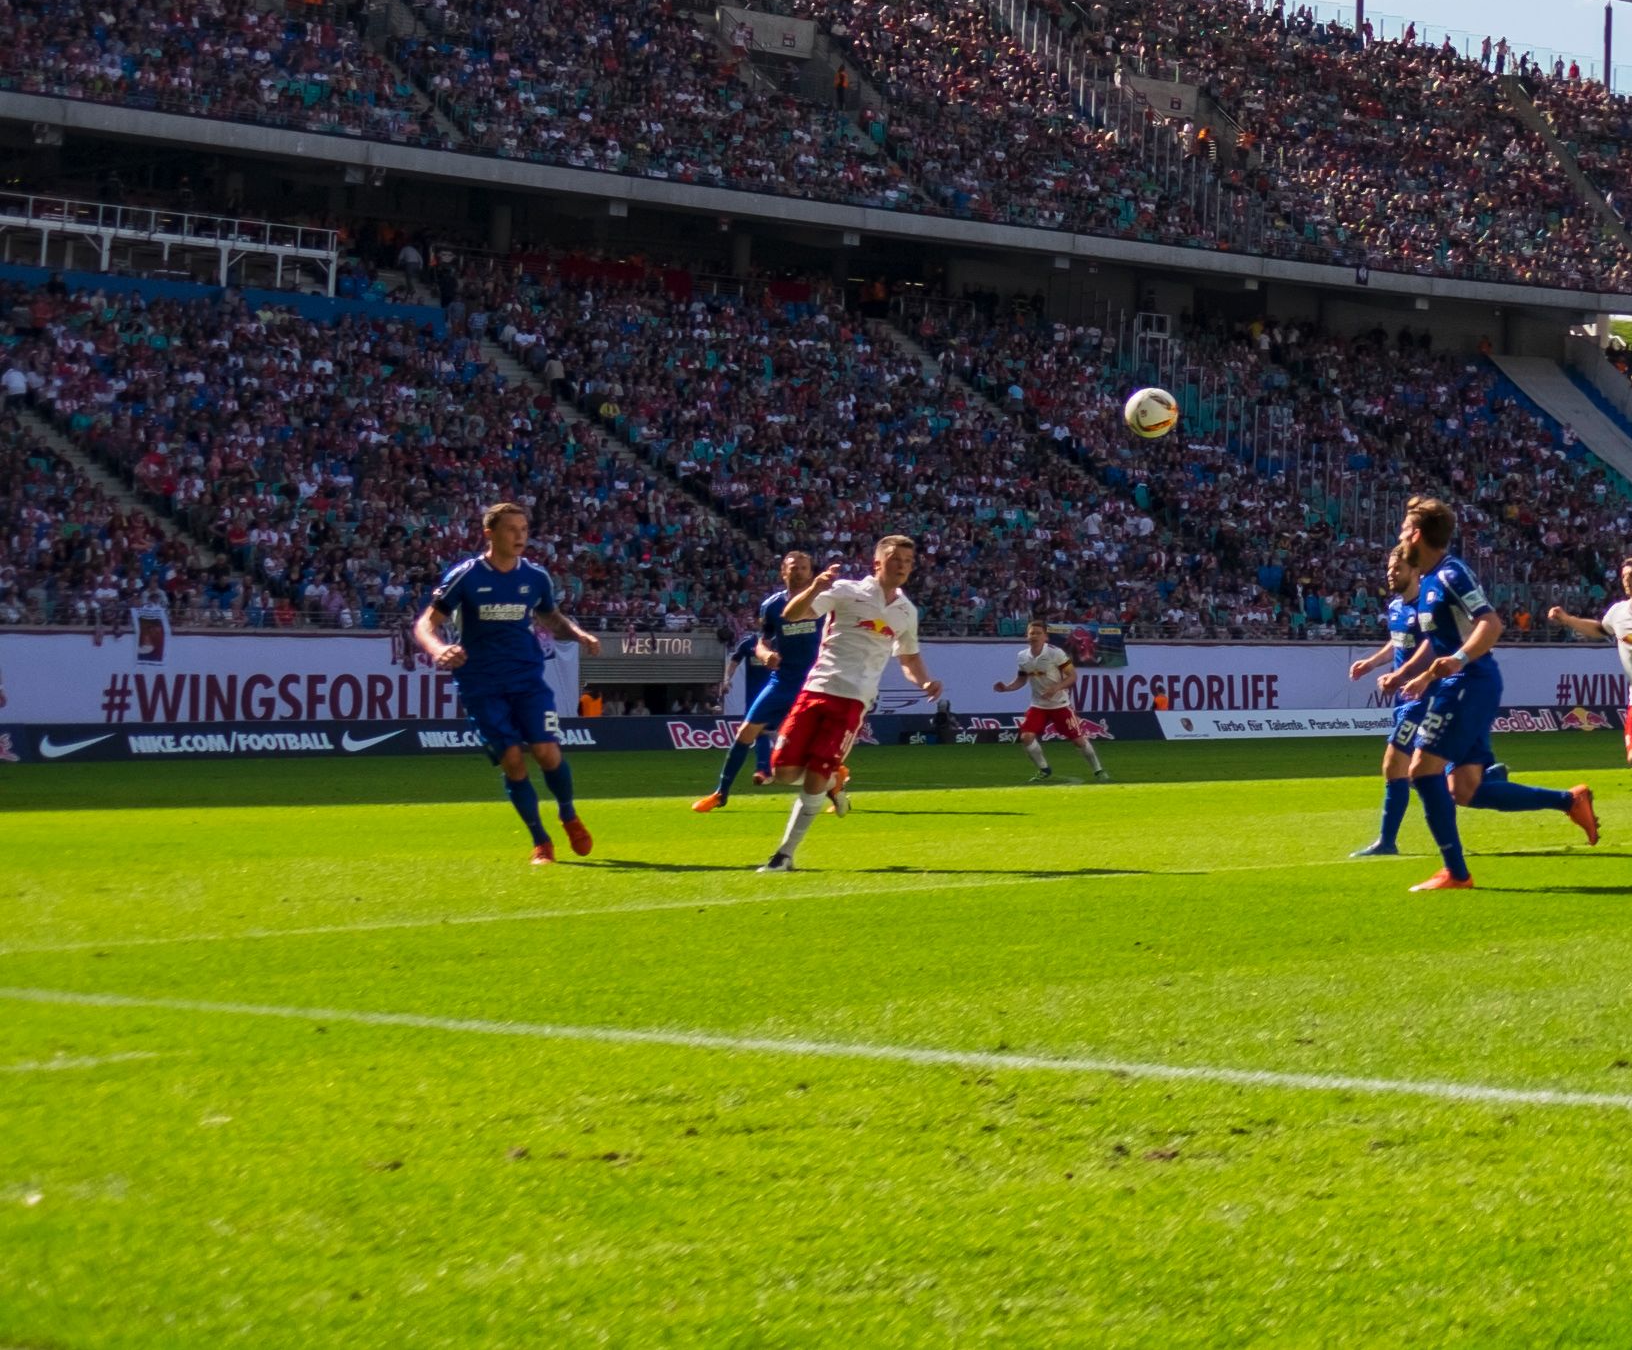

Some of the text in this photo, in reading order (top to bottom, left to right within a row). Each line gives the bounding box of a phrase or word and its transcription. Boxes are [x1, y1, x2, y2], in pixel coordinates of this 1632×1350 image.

[102, 674, 467, 723] #WINGSFORLIF
[1213, 720, 1245, 732] Turbo
[1308, 718, 1349, 730] Porsche
[129, 731, 334, 754] NIKE.COM/FOOTBALL
[955, 730, 977, 744] sky
[998, 730, 1018, 744] sky
